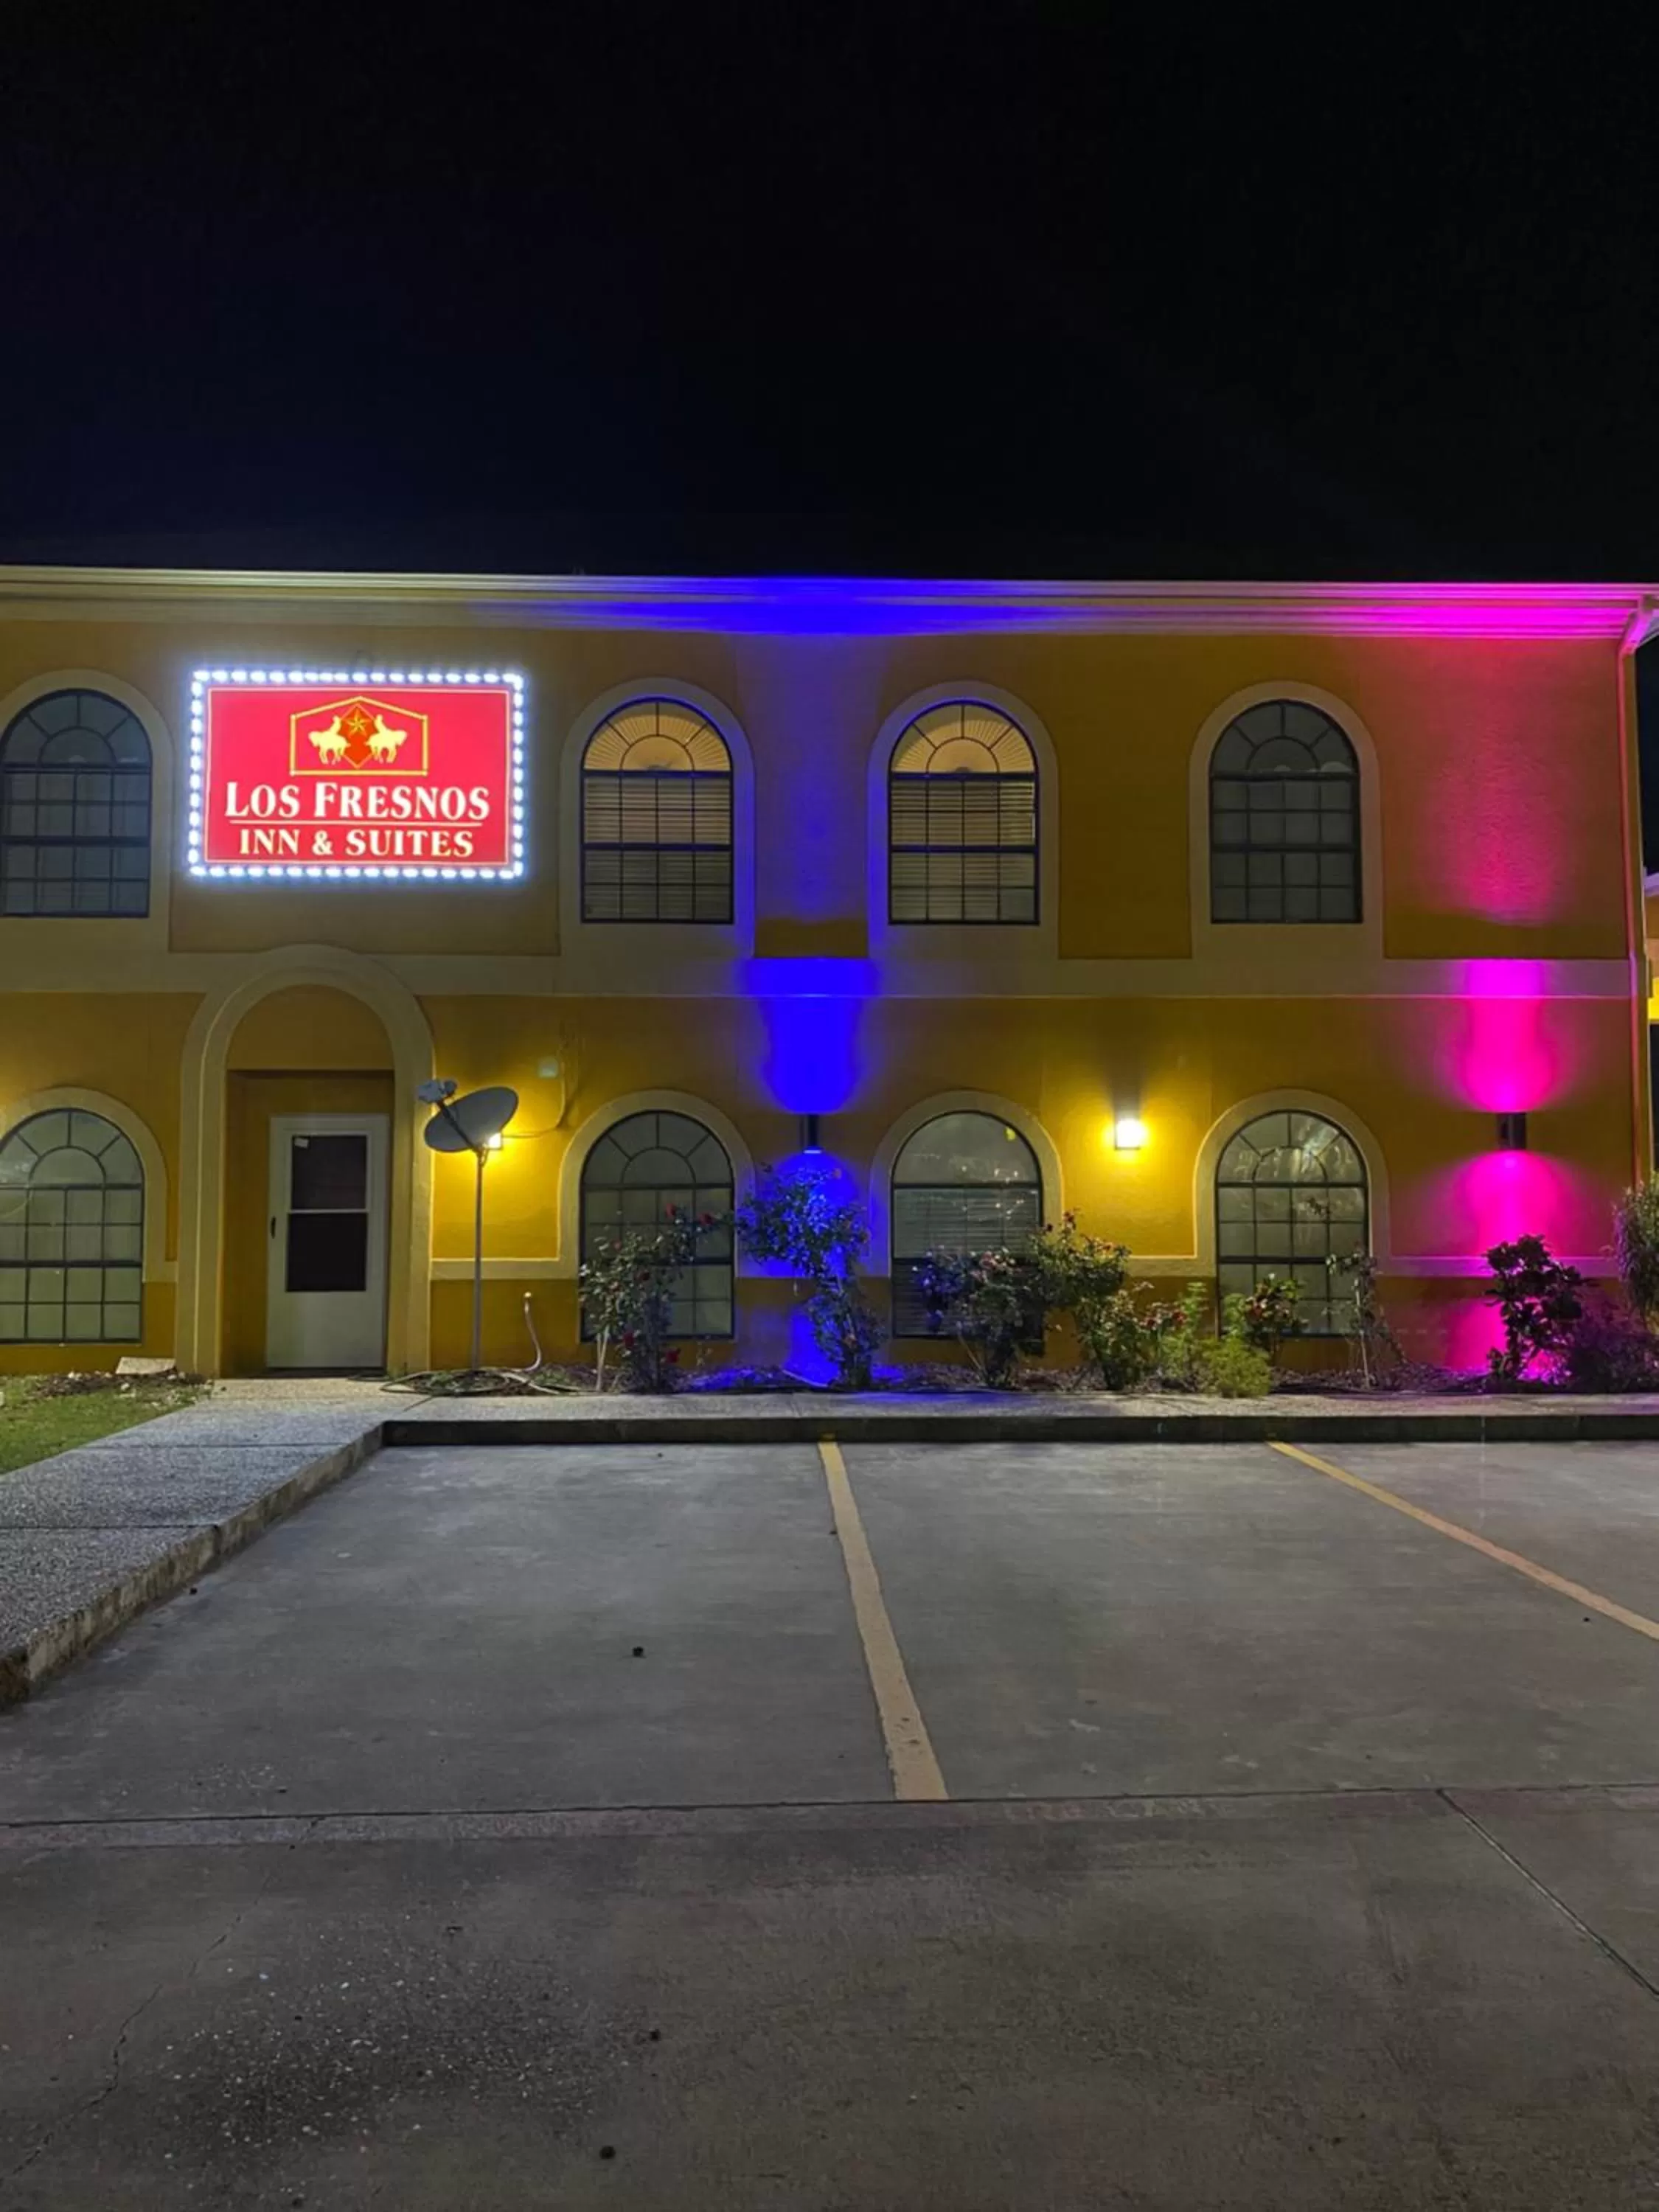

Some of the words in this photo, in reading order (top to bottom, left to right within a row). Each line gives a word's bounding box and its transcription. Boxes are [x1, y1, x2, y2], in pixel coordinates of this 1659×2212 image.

[225, 782, 299, 818] LOS
[315, 782, 490, 821] FRESNOS
[240, 829, 299, 855] INN
[312, 830, 333, 855] &
[346, 830, 473, 858] SUITES
